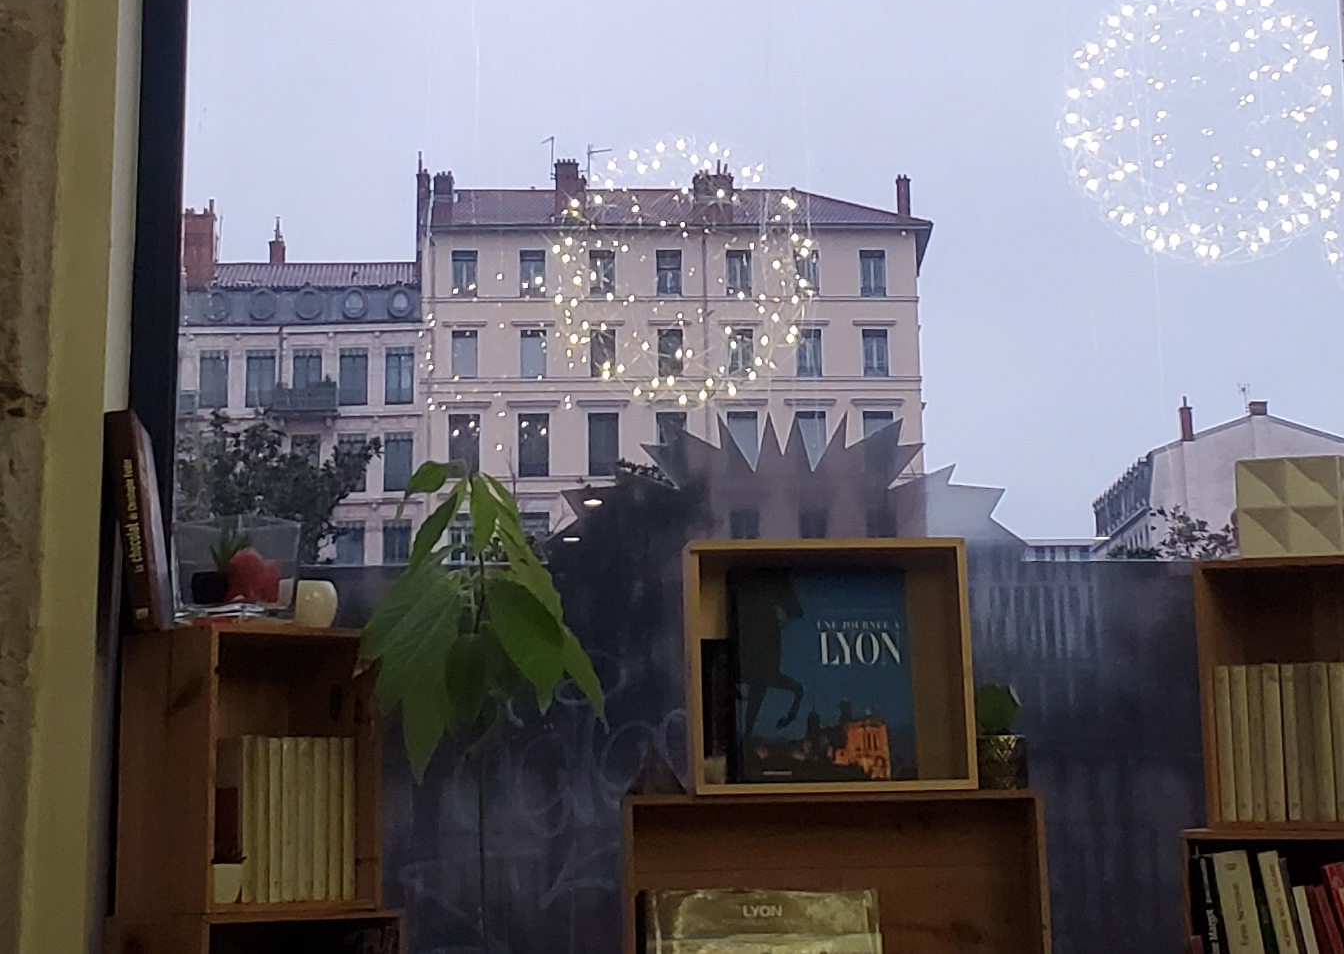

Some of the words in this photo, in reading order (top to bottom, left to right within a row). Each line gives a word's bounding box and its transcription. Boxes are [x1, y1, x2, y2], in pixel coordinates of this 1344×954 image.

[125, 522, 144, 562] chocolat
[820, 632, 901, 665] LYON
[743, 905, 783, 918] LYON
